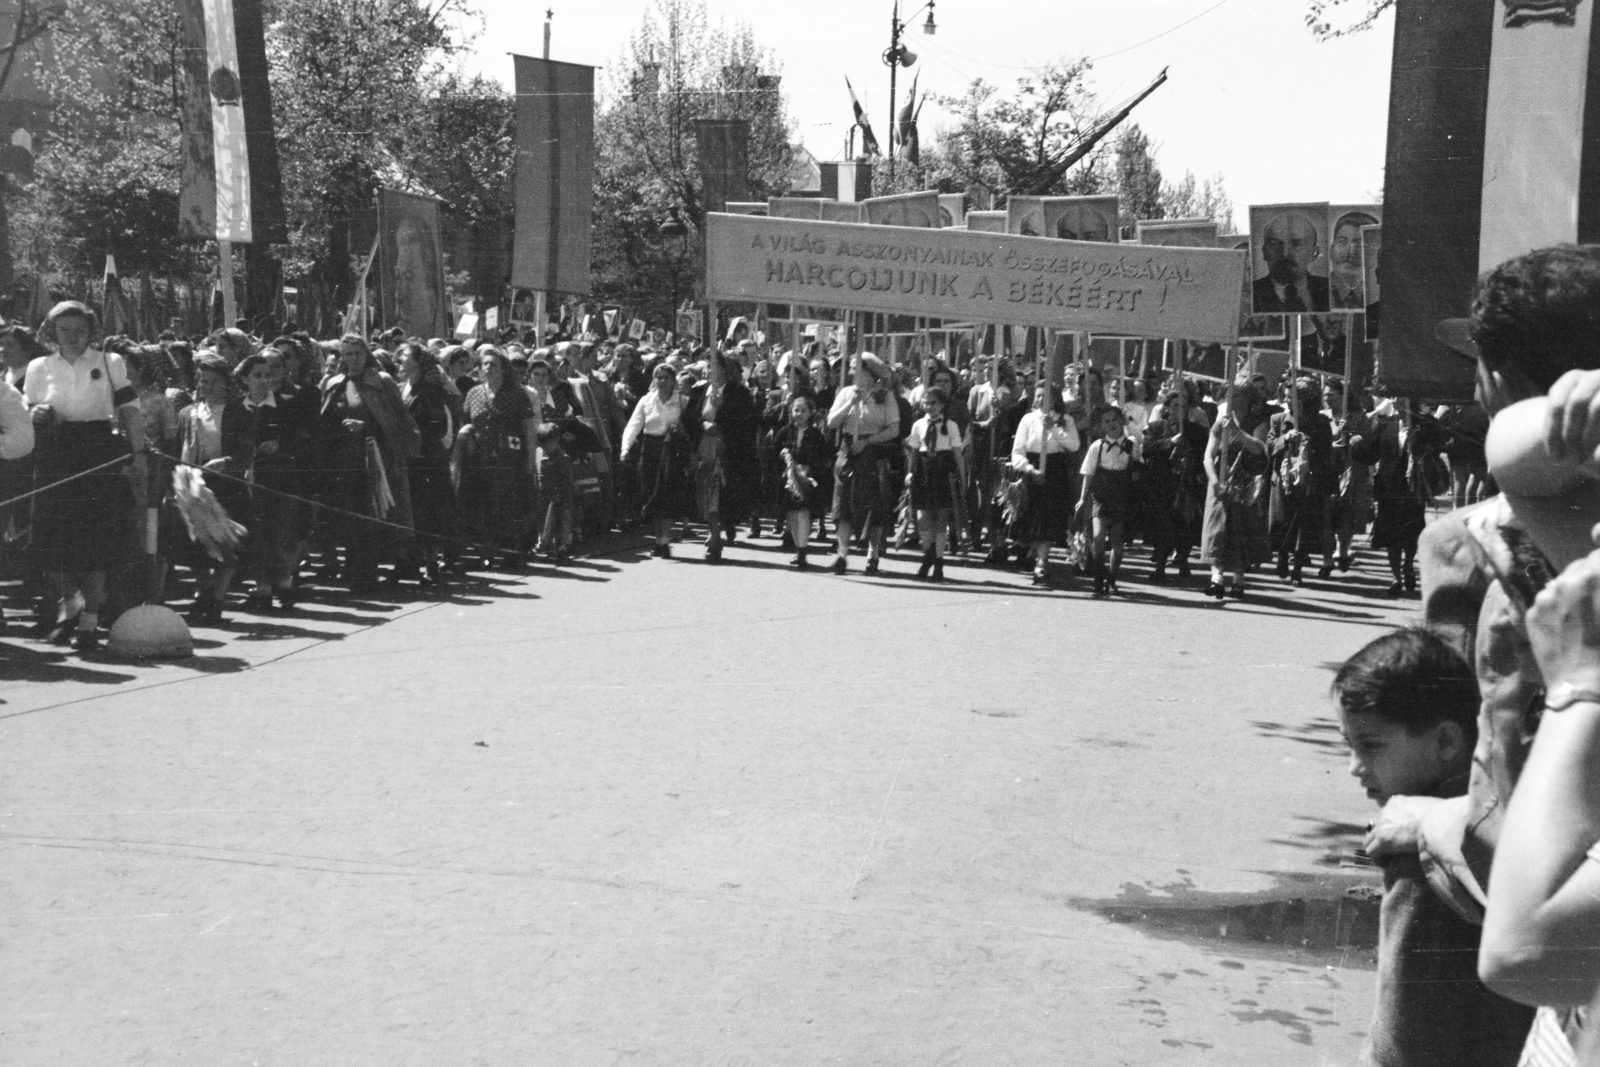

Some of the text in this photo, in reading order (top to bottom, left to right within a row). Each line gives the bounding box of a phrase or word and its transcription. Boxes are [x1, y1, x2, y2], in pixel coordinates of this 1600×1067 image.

[751, 234, 764, 250] A
[770, 232, 826, 255] VILÁG
[836, 240, 994, 268] ASSZONYAINAK
[765, 259, 959, 297] HARCOLJUNK
[970, 277, 994, 301] A
